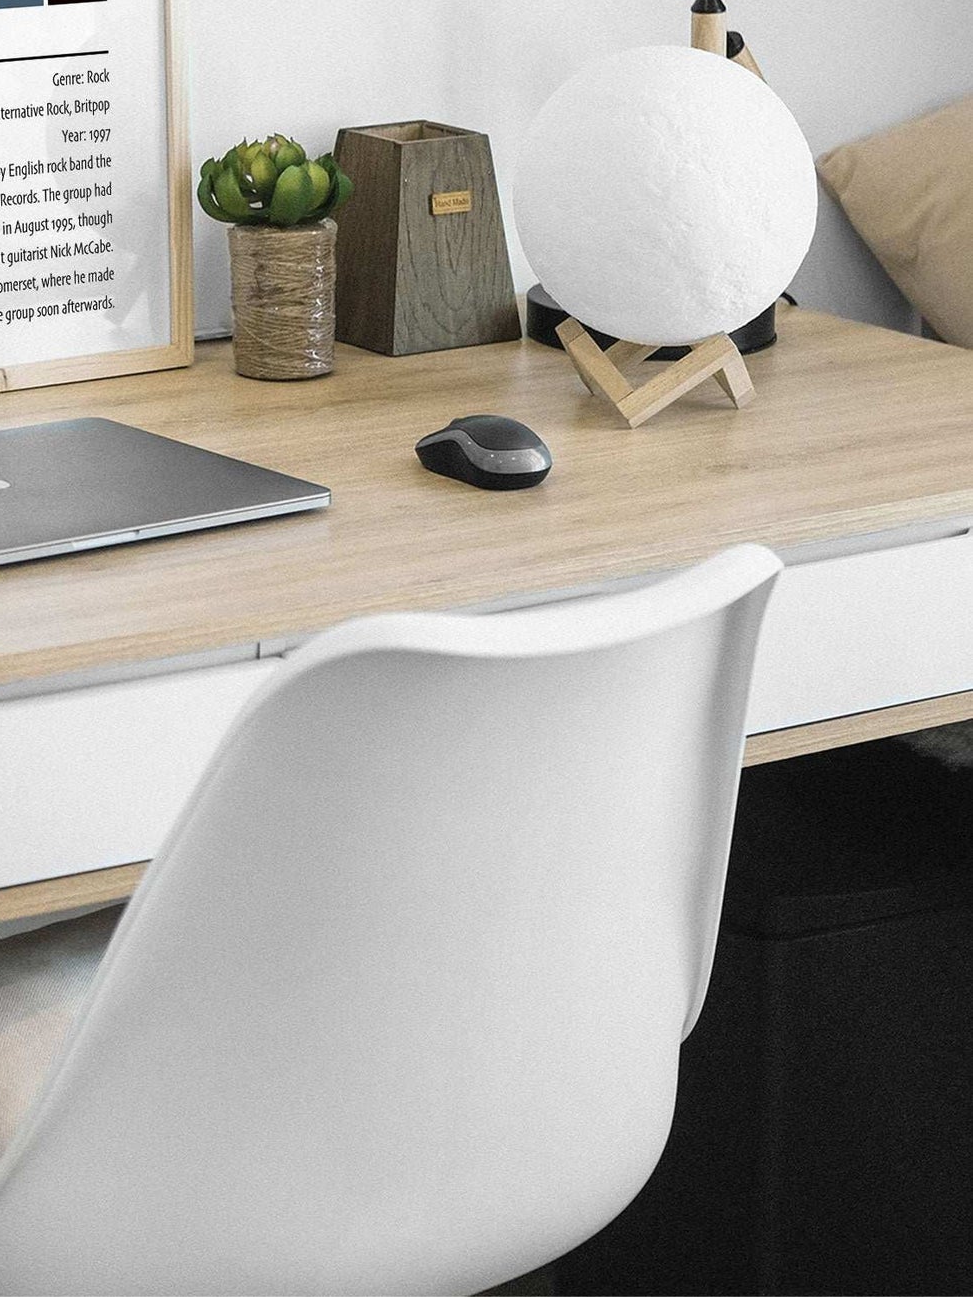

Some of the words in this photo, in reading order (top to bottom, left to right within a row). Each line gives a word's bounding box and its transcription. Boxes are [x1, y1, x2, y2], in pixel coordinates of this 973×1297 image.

[52, 72, 84, 86] Genre:
[87, 68, 110, 83] Rock
[46, 99, 72, 116] Rock,
[74, 98, 110, 116] Britpop
[61, 129, 86, 143] Year:
[88, 128, 111, 143] 1997
[8, 159, 44, 180] English
[46, 157, 67, 173] rock
[69, 154, 93, 171] band
[95, 153, 111, 168] the
[0, 189, 40, 206] Records.
[42, 187, 60, 202] The
[62, 187, 92, 204] group
[94, 181, 112, 197] had
[2, 221, 12, 235] in
[14, 218, 49, 236] August
[51, 217, 75, 232] 1995,
[77, 209, 112, 229] though
[6, 246, 48, 267] guitarist
[50, 242, 72, 258] Nick
[73, 238, 113, 256] McCabe.
[40, 272, 71, 288] where
[73, 270, 86, 284] he
[87, 266, 114, 283] made
[5, 307, 34, 325] group
[36, 304, 59, 317] soon
[61, 294, 115, 314] afterwards.
